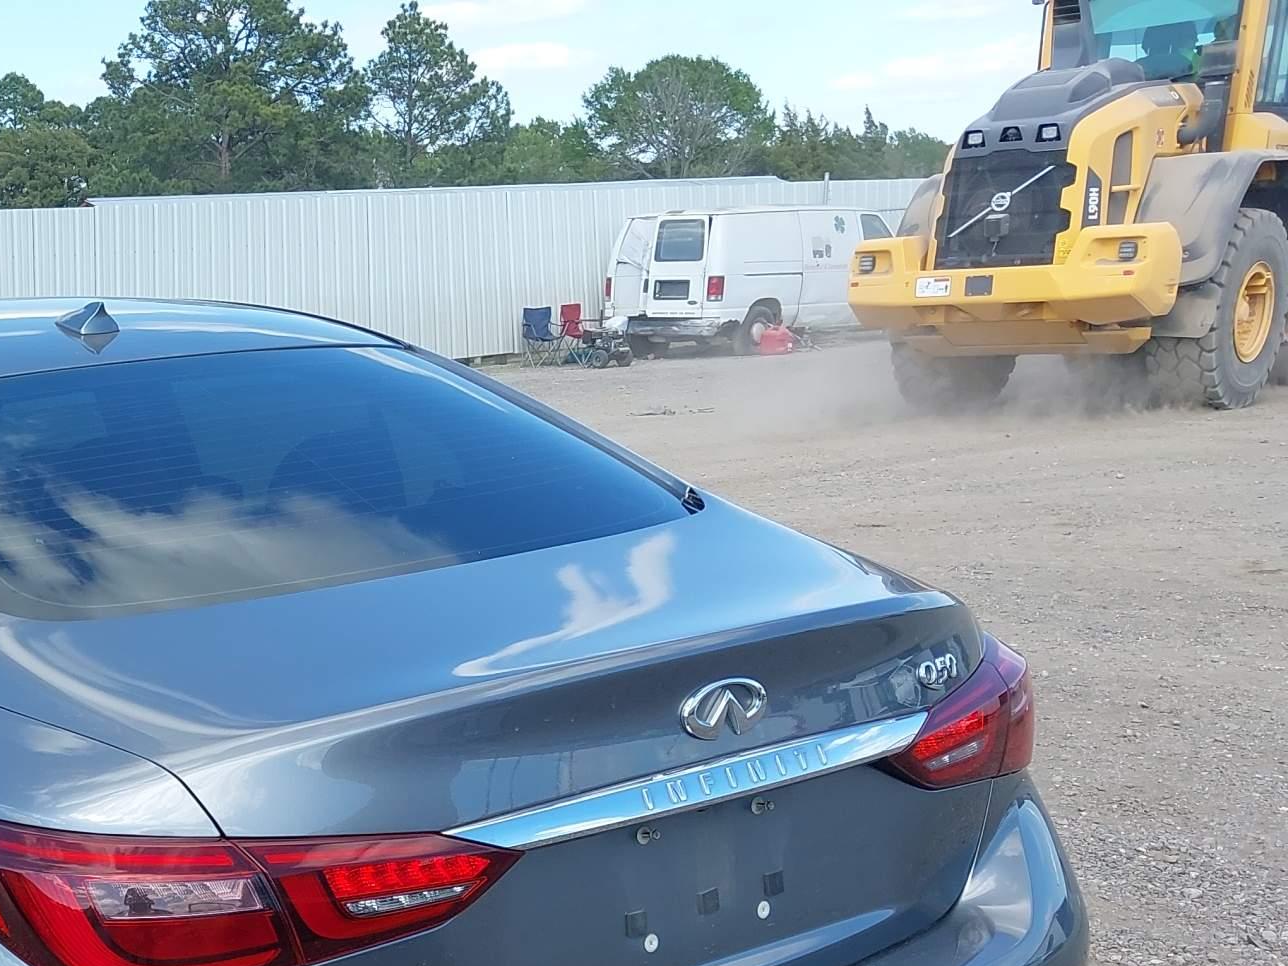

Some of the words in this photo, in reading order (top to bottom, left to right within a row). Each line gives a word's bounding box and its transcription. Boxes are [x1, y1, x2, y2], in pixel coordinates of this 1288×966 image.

[1087, 187, 1100, 220] L90H
[917, 653, 957, 688] Q50
[641, 743, 830, 811] INFINITI
